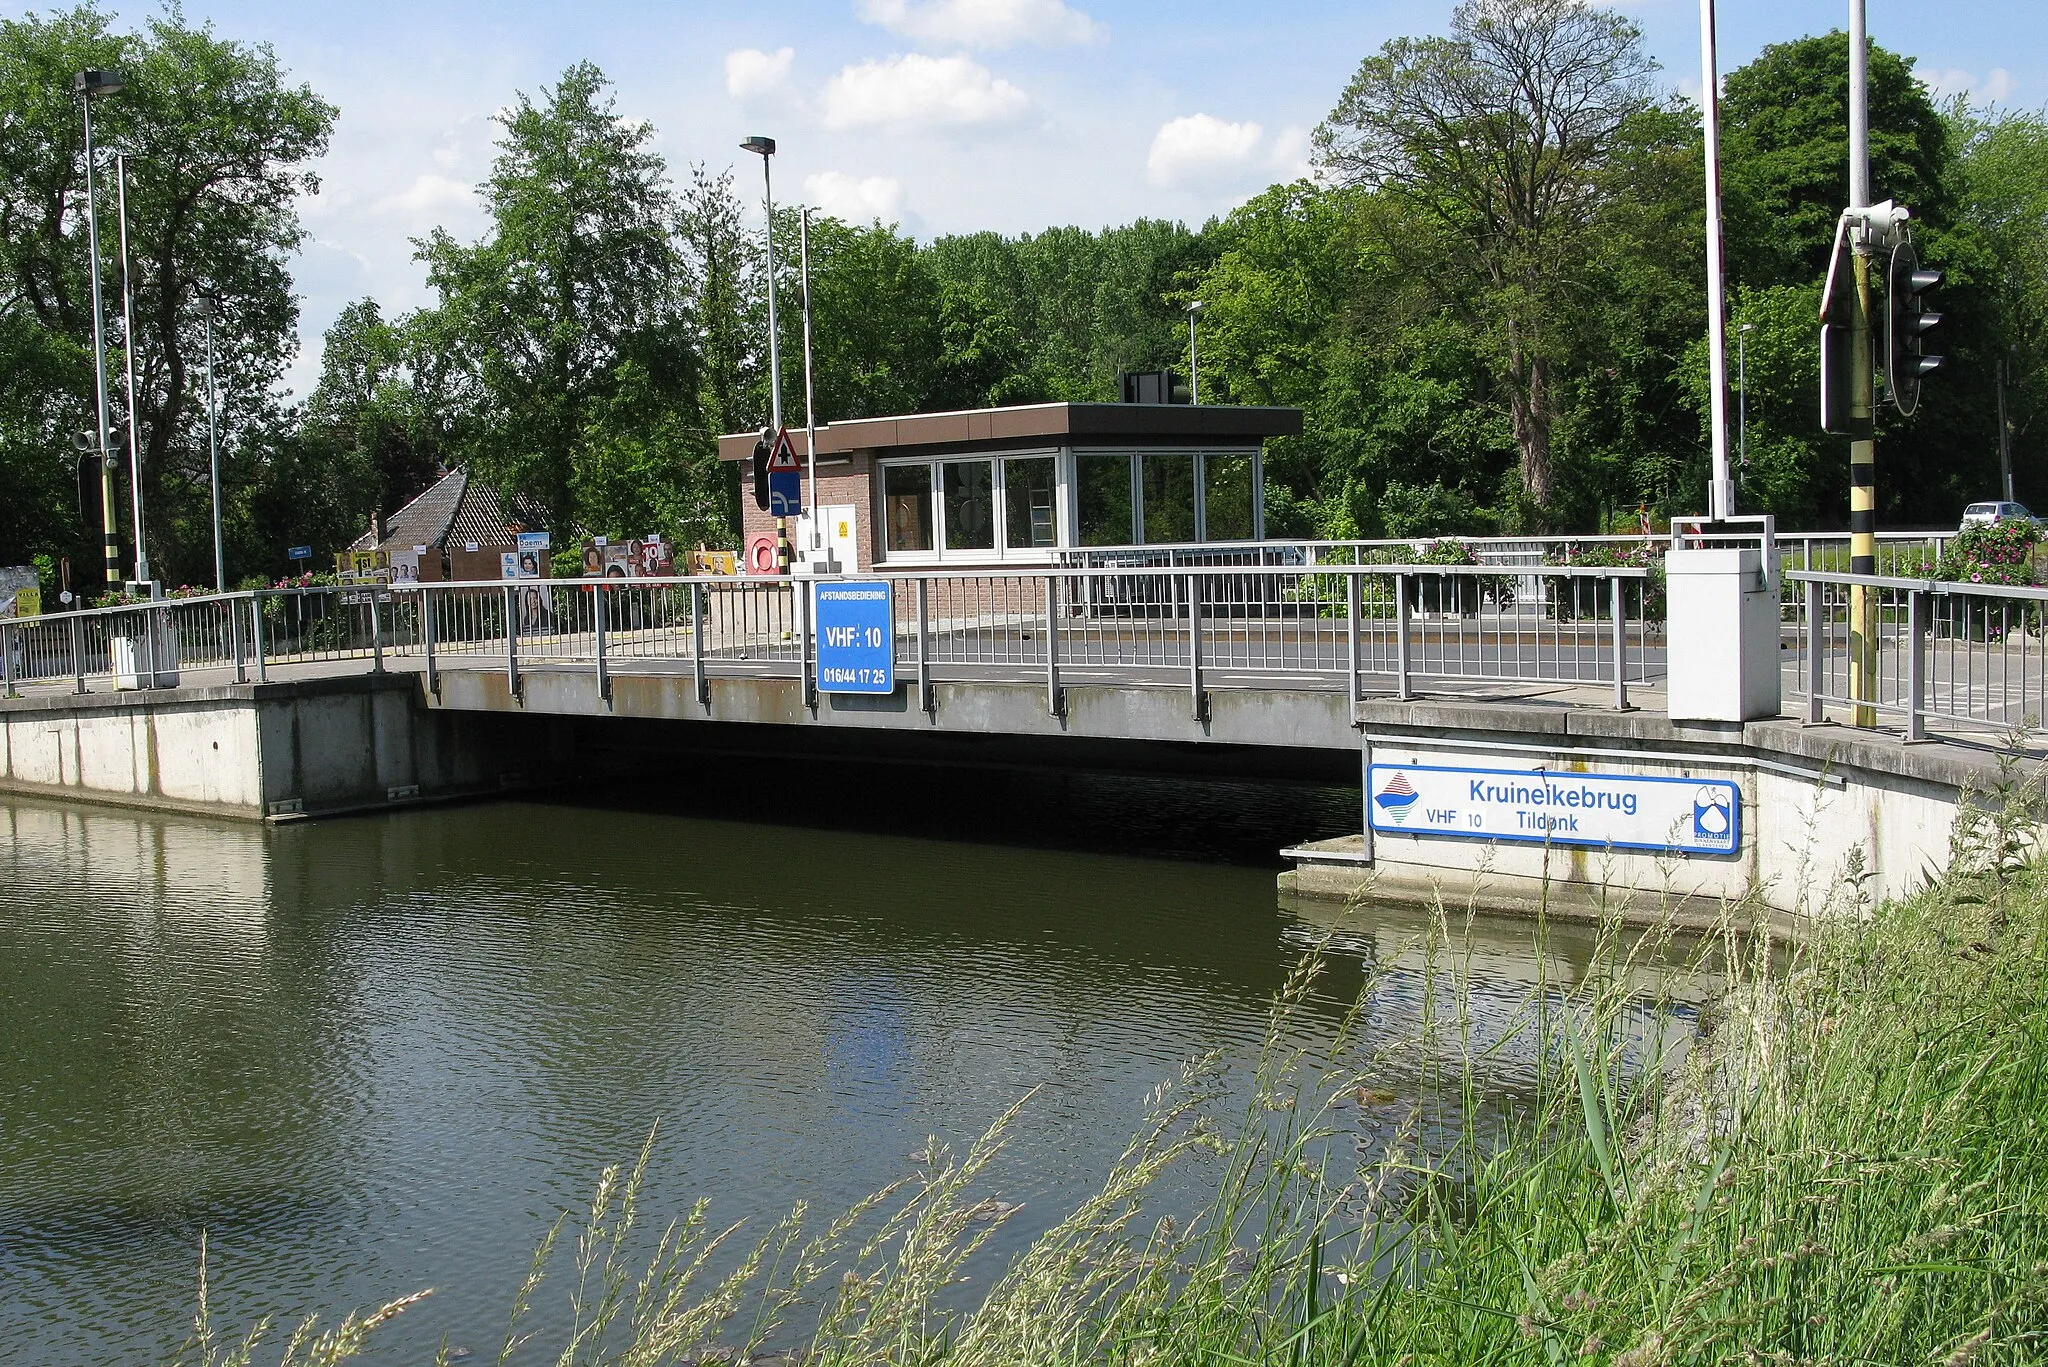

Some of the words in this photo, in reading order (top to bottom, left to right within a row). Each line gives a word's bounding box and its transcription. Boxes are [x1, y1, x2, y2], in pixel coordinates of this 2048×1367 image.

[820, 590, 886, 600] AFSTANDSBEDIENING
[826, 626, 860, 648] VHF:
[864, 627, 882, 648] 10
[824, 668, 856, 684] 016/44
[858, 668, 870, 684] 17
[873, 669, 886, 684] 25
[1470, 780, 1637, 816] Kruineikebrug
[1426, 808, 1456, 824] VHF
[1468, 814, 1482, 828] 10
[1516, 811, 1578, 832] Tildonk
